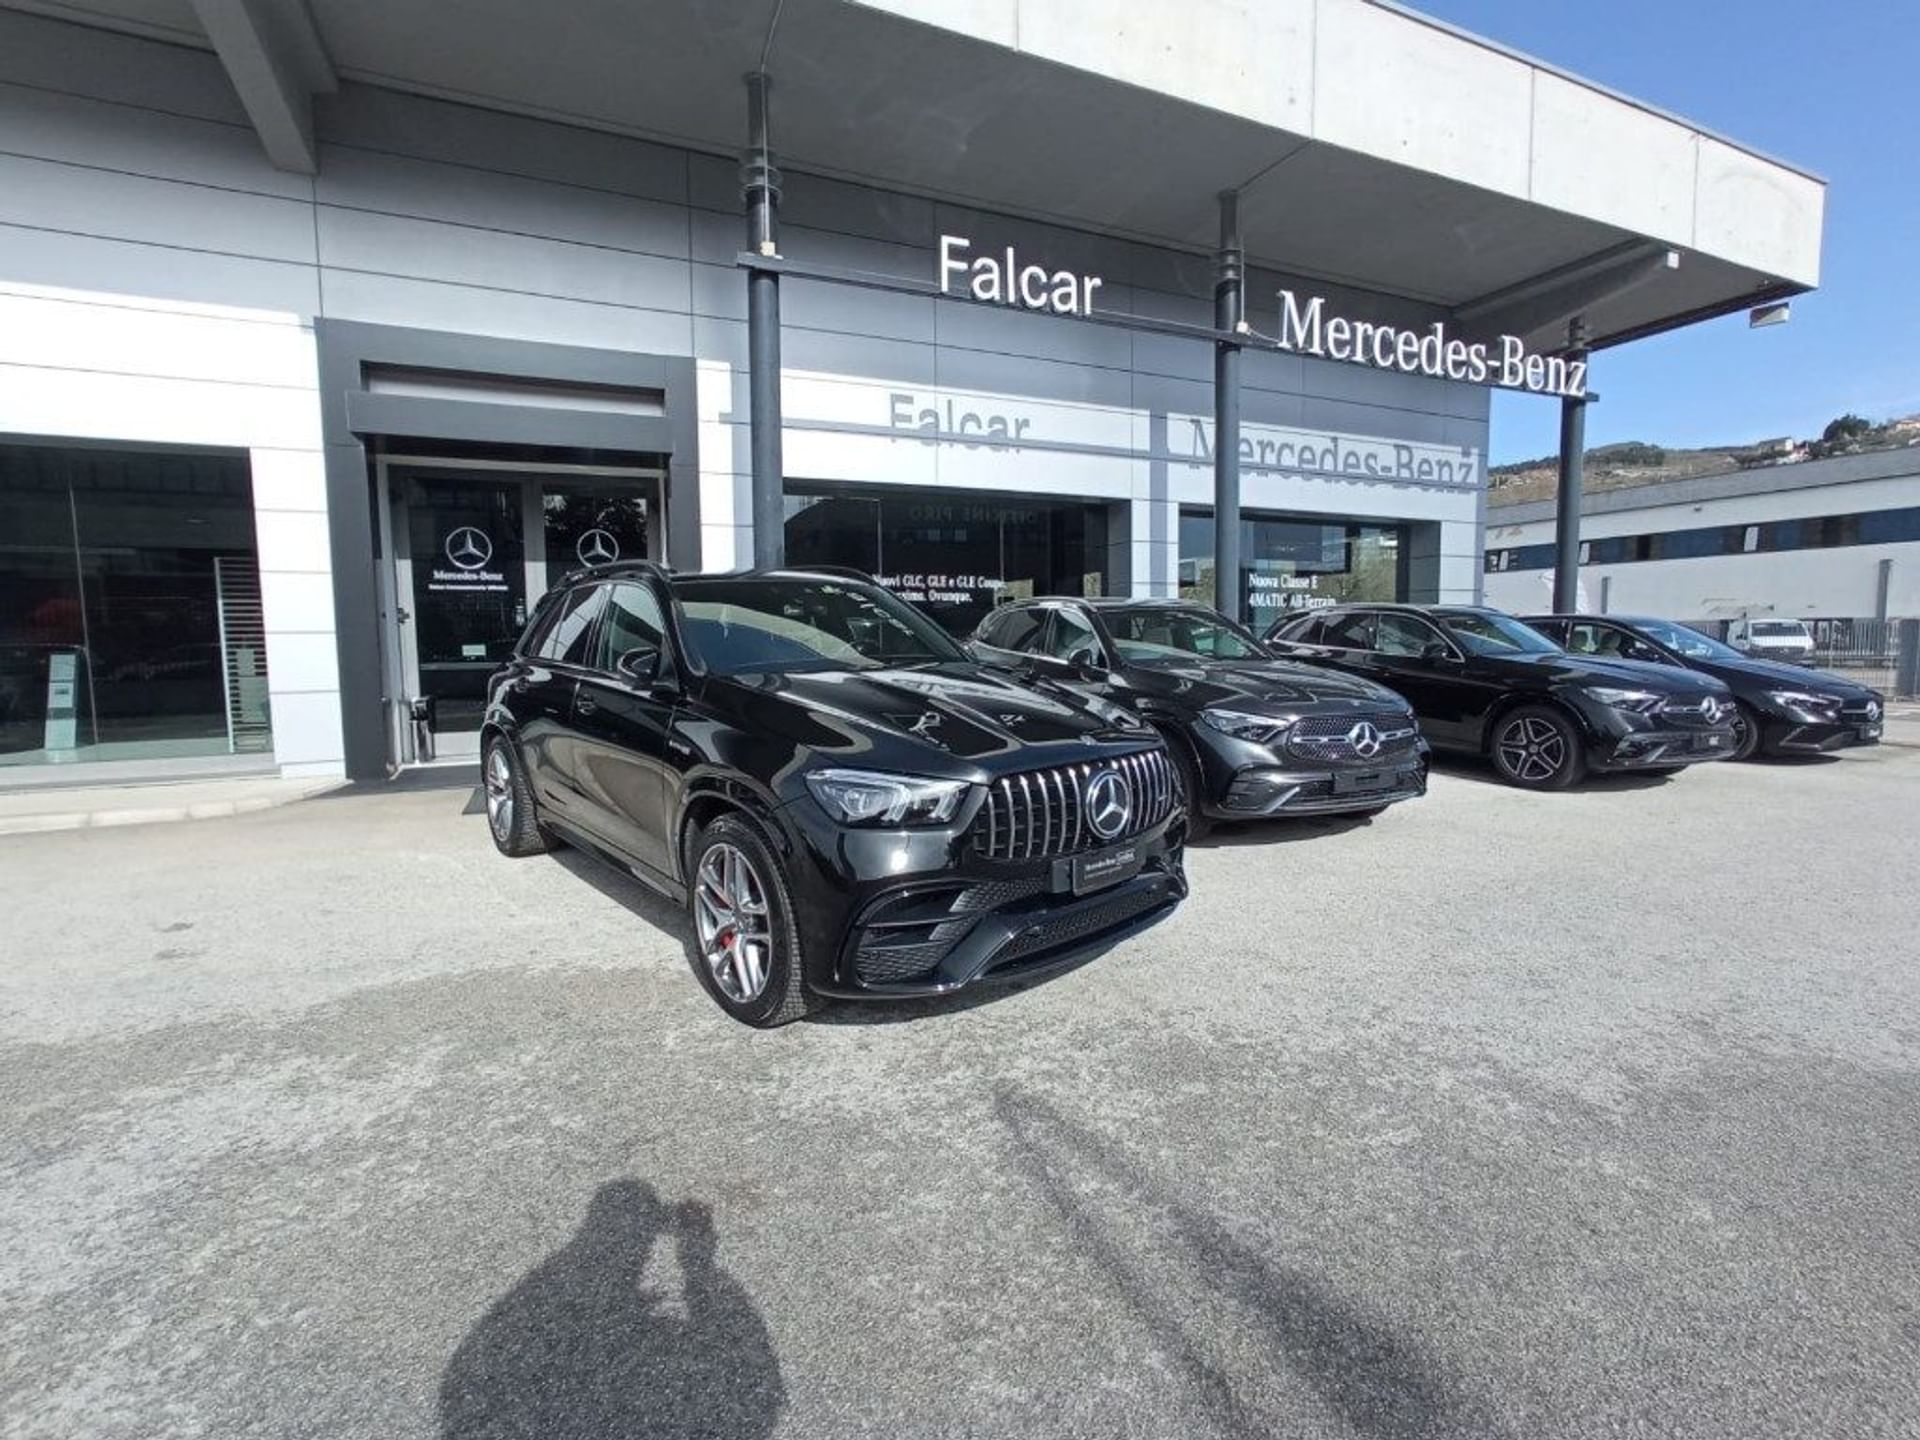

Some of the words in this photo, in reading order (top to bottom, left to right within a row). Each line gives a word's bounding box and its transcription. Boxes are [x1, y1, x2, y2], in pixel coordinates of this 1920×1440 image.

[940, 234, 1103, 316] Falcar
[1277, 289, 1588, 397] Mercedes-Benz
[927, 575, 947, 588] GLE
[956, 575, 976, 588] GLE
[1248, 573, 1279, 588] Nuova
